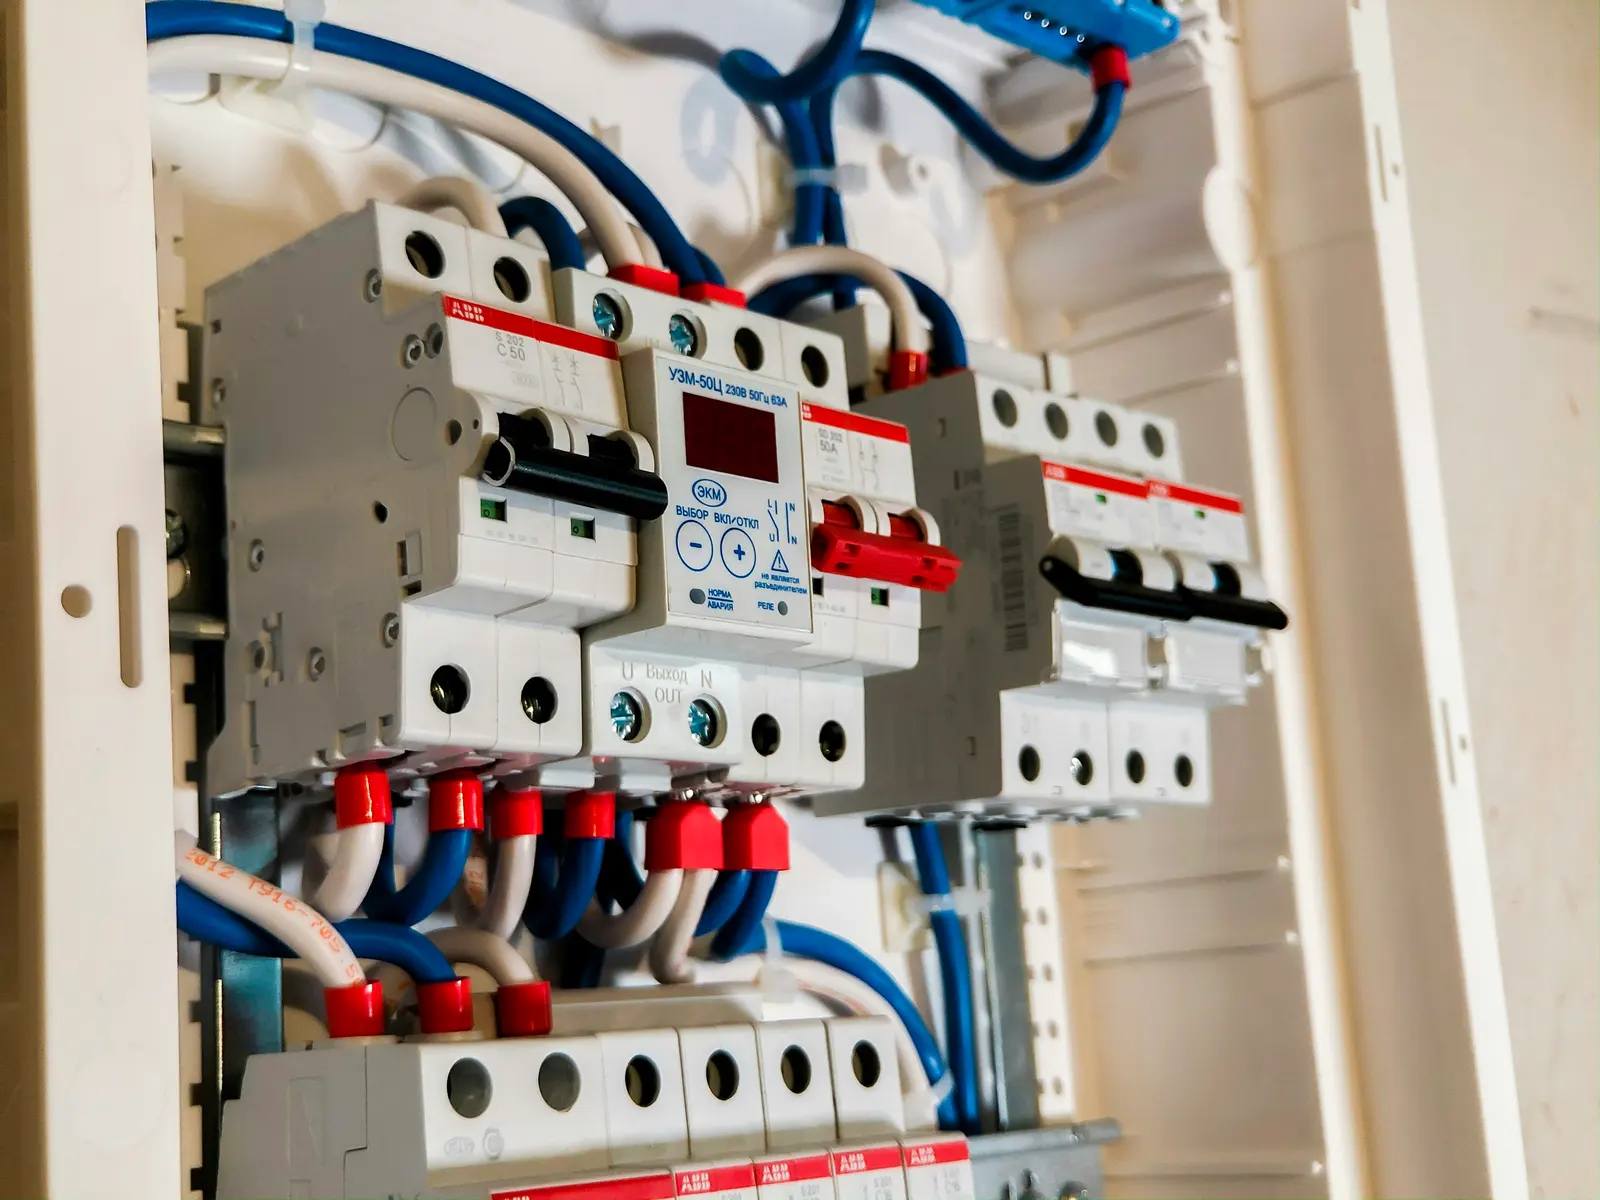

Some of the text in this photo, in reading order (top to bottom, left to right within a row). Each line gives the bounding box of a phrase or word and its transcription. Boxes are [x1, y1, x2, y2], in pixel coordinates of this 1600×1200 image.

[452, 301, 485, 322] ABB
[495, 331, 524, 348] S 202
[510, 346, 526, 361] 50
[668, 366, 788, 408] УЗМ-50Ц 230В 50Гц 63А
[697, 485, 721, 501] ЭКМ
[676, 505, 760, 529] ВЫБОР ВКЛ/ОТКЛ
[708, 588, 732, 599] НОРМА
[707, 600, 734, 611] АВАРИЯ
[757, 601, 775, 611] РЕЛЕ
[622, 661, 713, 689] U Выход N
[655, 687, 682, 703] OUT
[839, 1153, 867, 1172] ABB
[909, 1147, 937, 1165] ABB
[681, 1172, 711, 1192] ABB
[762, 1163, 791, 1183] ABB
